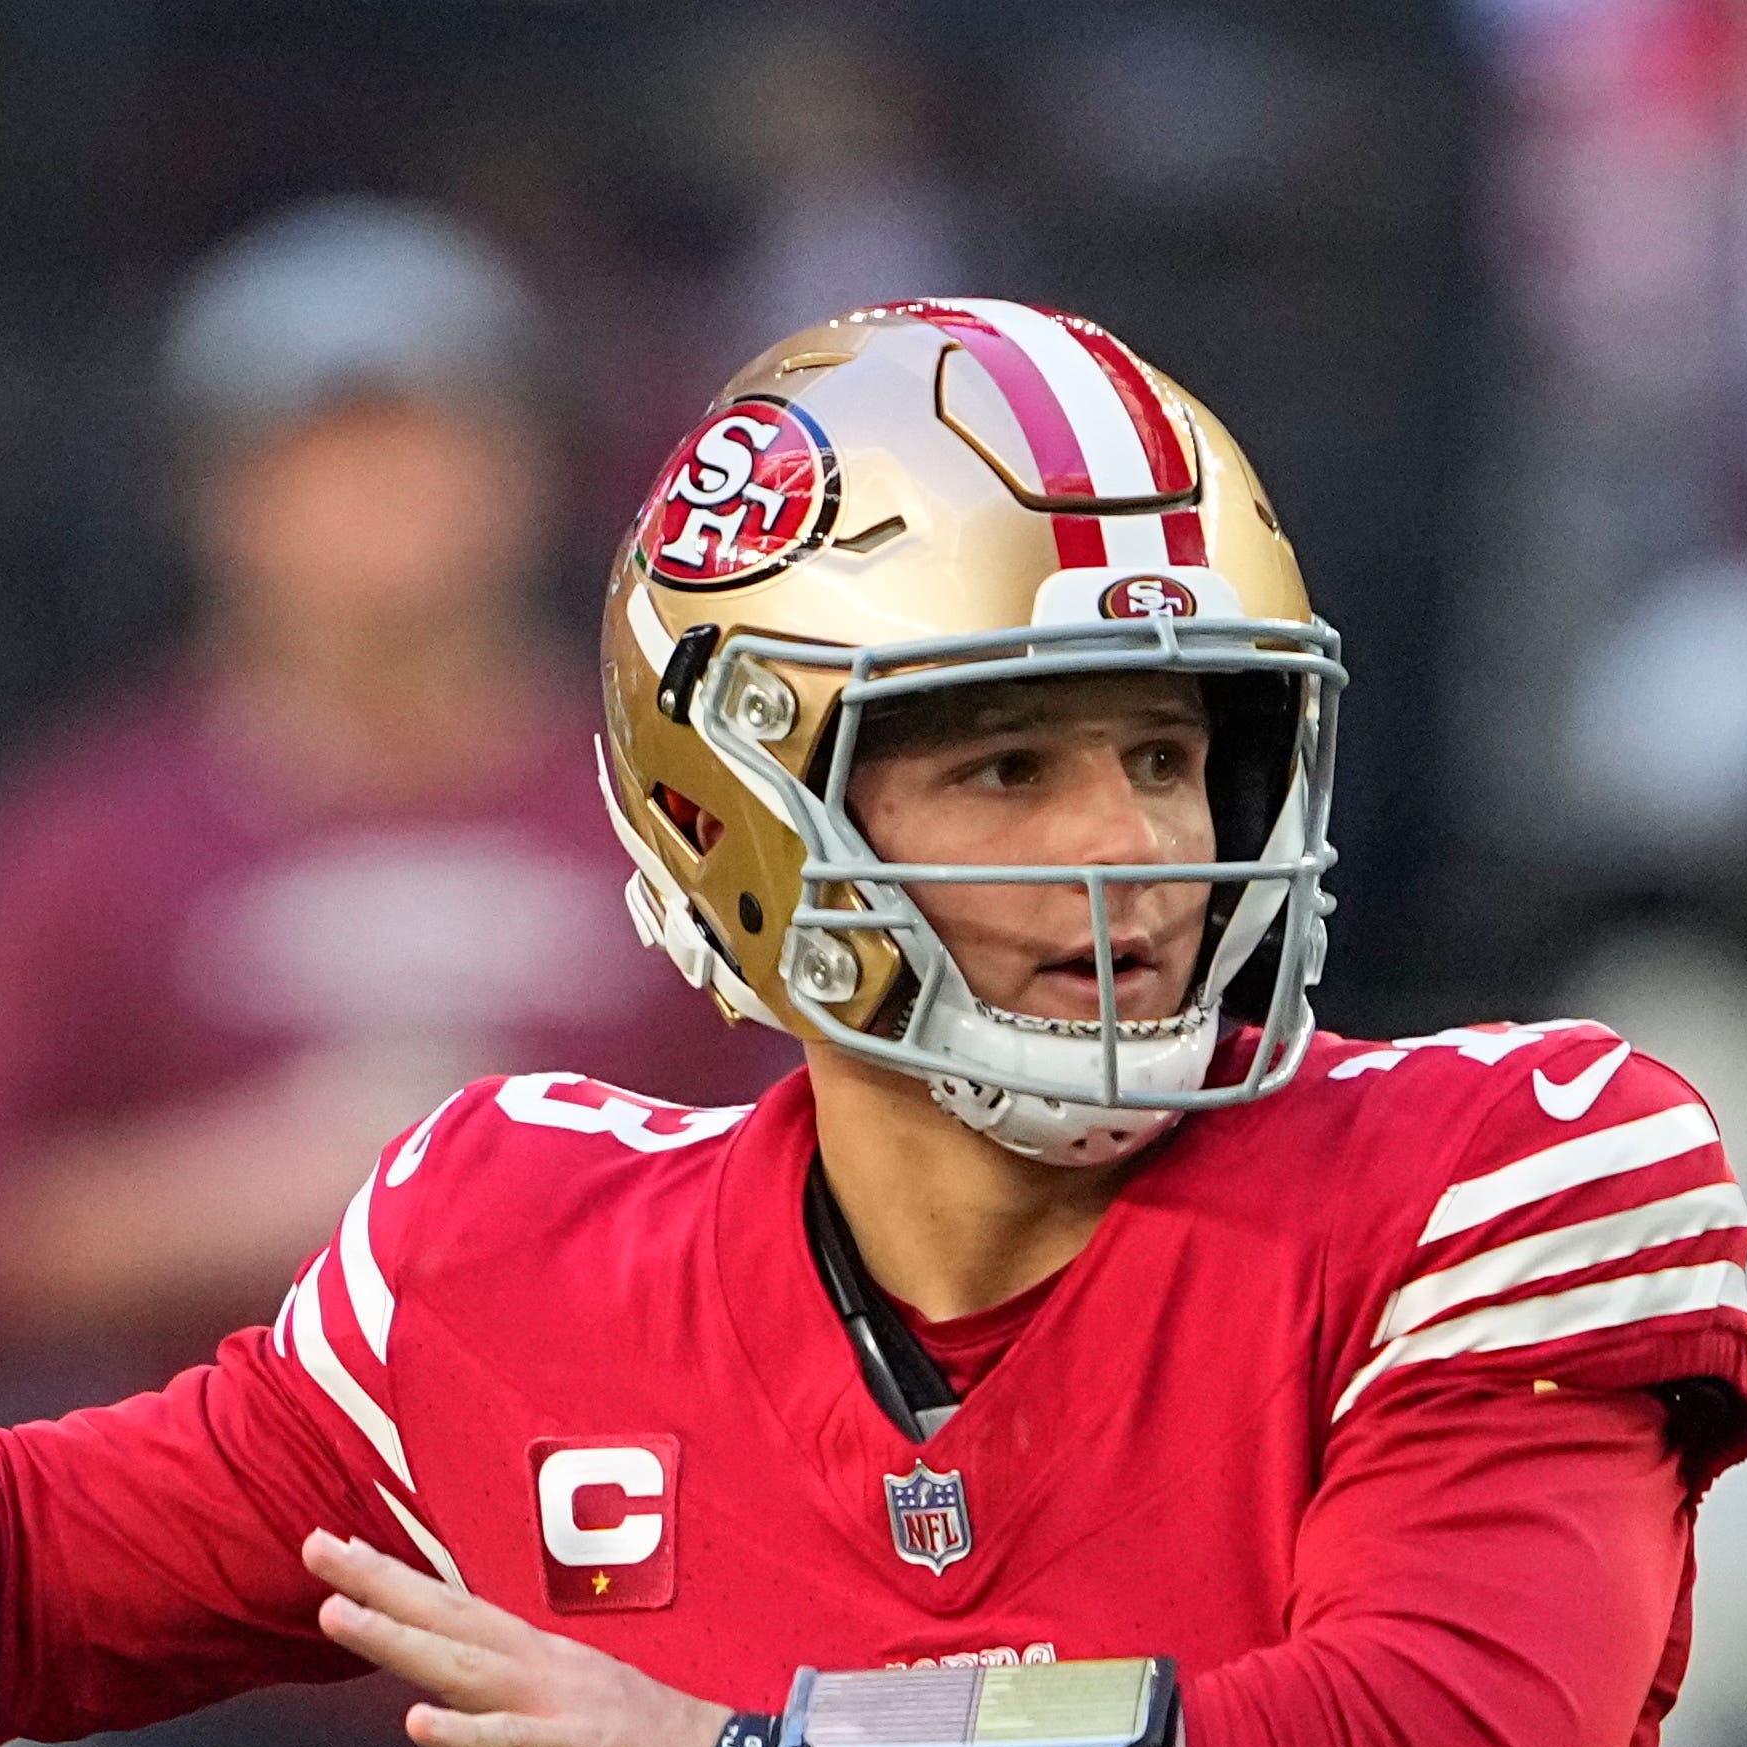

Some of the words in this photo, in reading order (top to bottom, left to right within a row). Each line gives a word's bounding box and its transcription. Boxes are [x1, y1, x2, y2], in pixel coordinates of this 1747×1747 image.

[660, 415, 786, 568] SF
[537, 1445, 665, 1568] C
[902, 1512, 960, 1554] NFL
